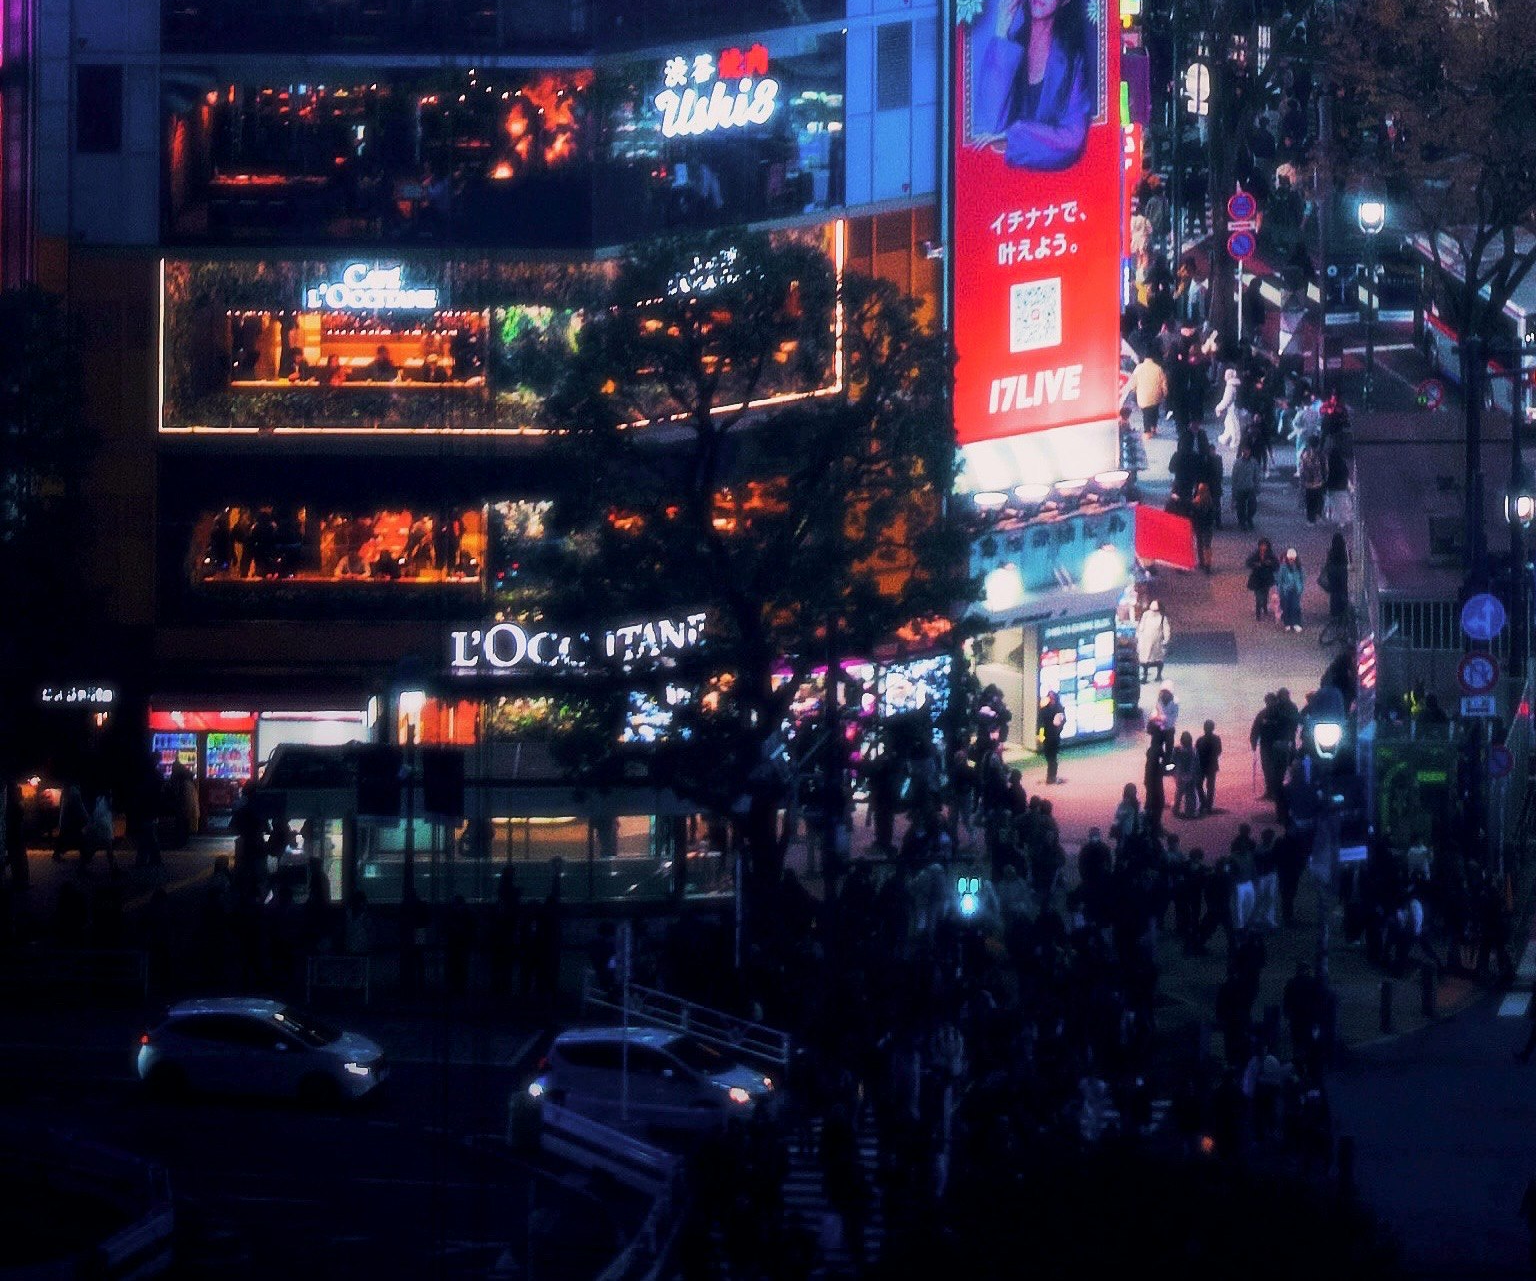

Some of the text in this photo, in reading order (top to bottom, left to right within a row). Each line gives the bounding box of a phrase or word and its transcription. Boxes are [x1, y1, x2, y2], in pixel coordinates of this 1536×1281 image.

[654, 78, 779, 137] Ushi8
[998, 233, 1078, 265] 叶えよう。
